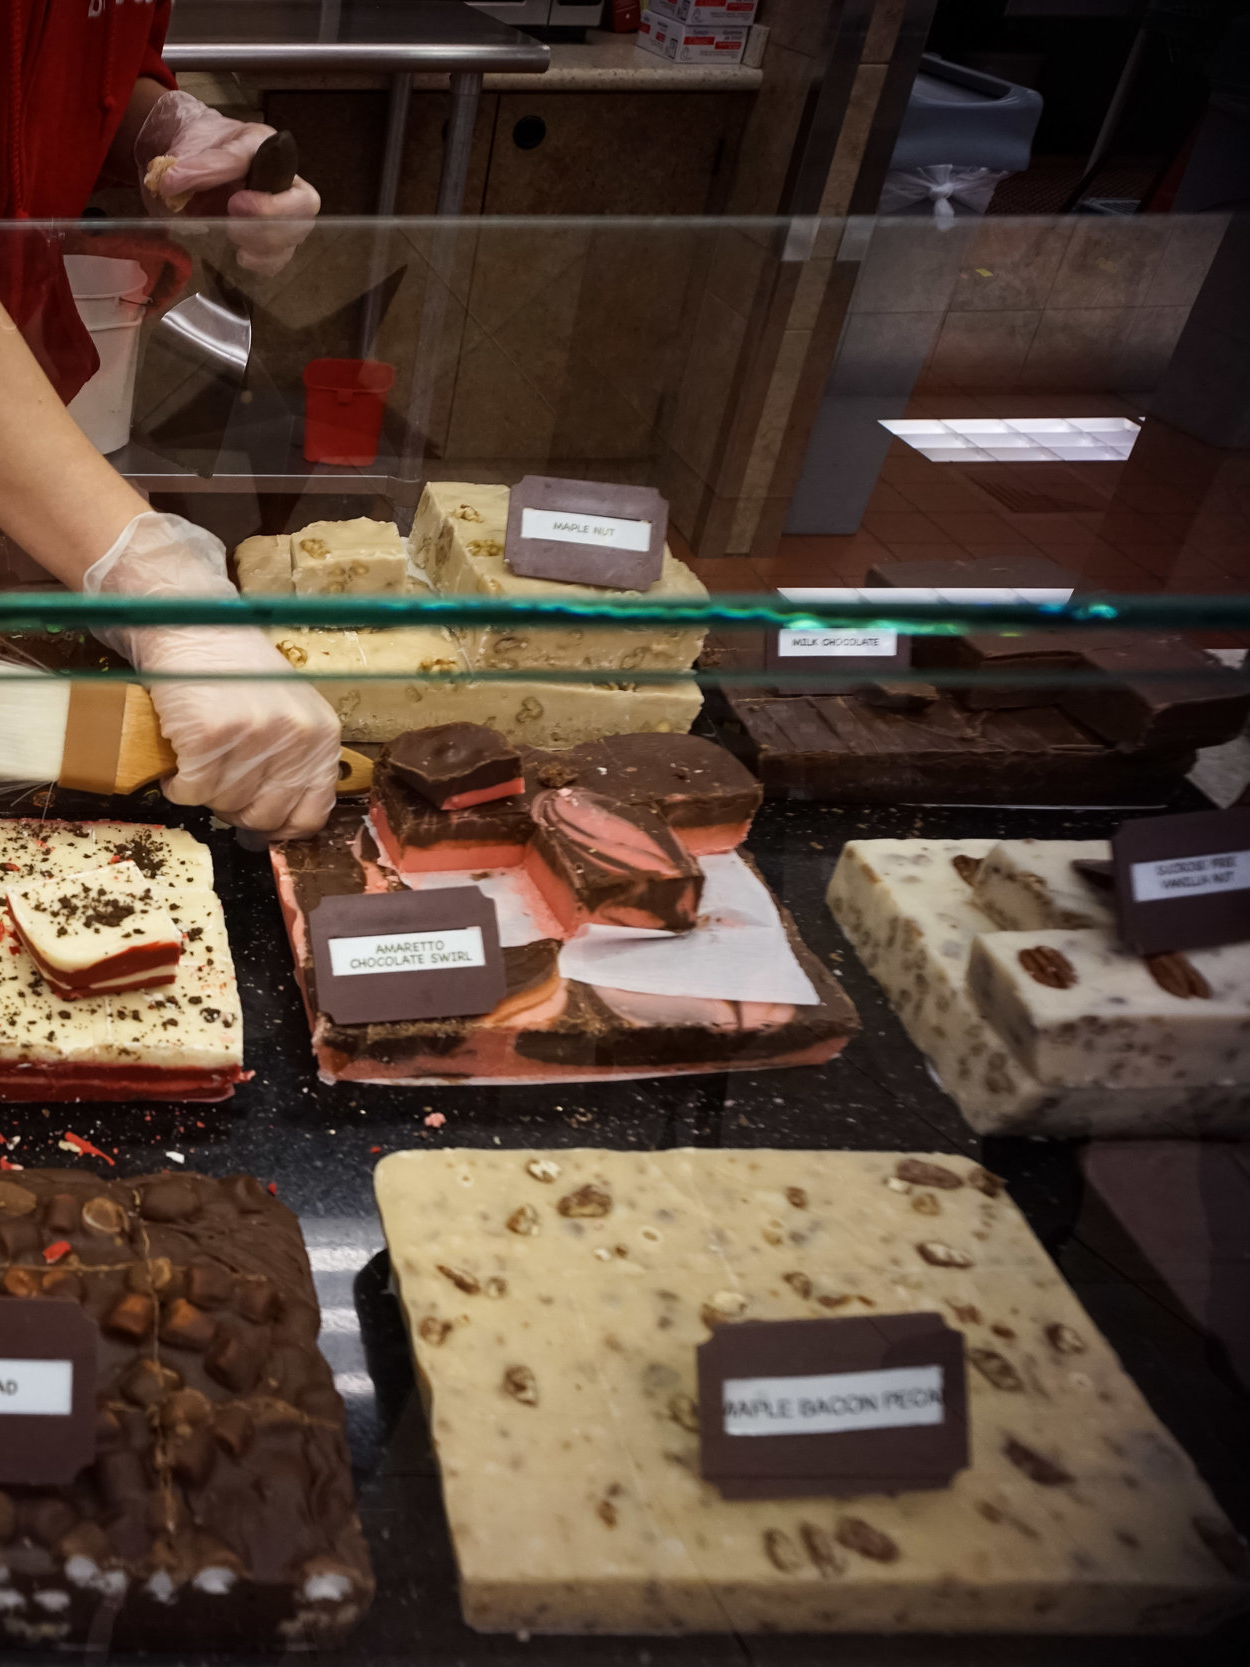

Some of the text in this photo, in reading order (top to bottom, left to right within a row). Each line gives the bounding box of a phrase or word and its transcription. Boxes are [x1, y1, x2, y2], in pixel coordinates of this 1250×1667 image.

[553, 522, 615, 537] MAPLE NUT
[792, 638, 879, 647] MILK CHOCOLATE
[376, 940, 445, 955] AMARETTO
[350, 951, 473, 969] CHOCOLATE SWIRL
[796, 1393, 880, 1418] BACON
